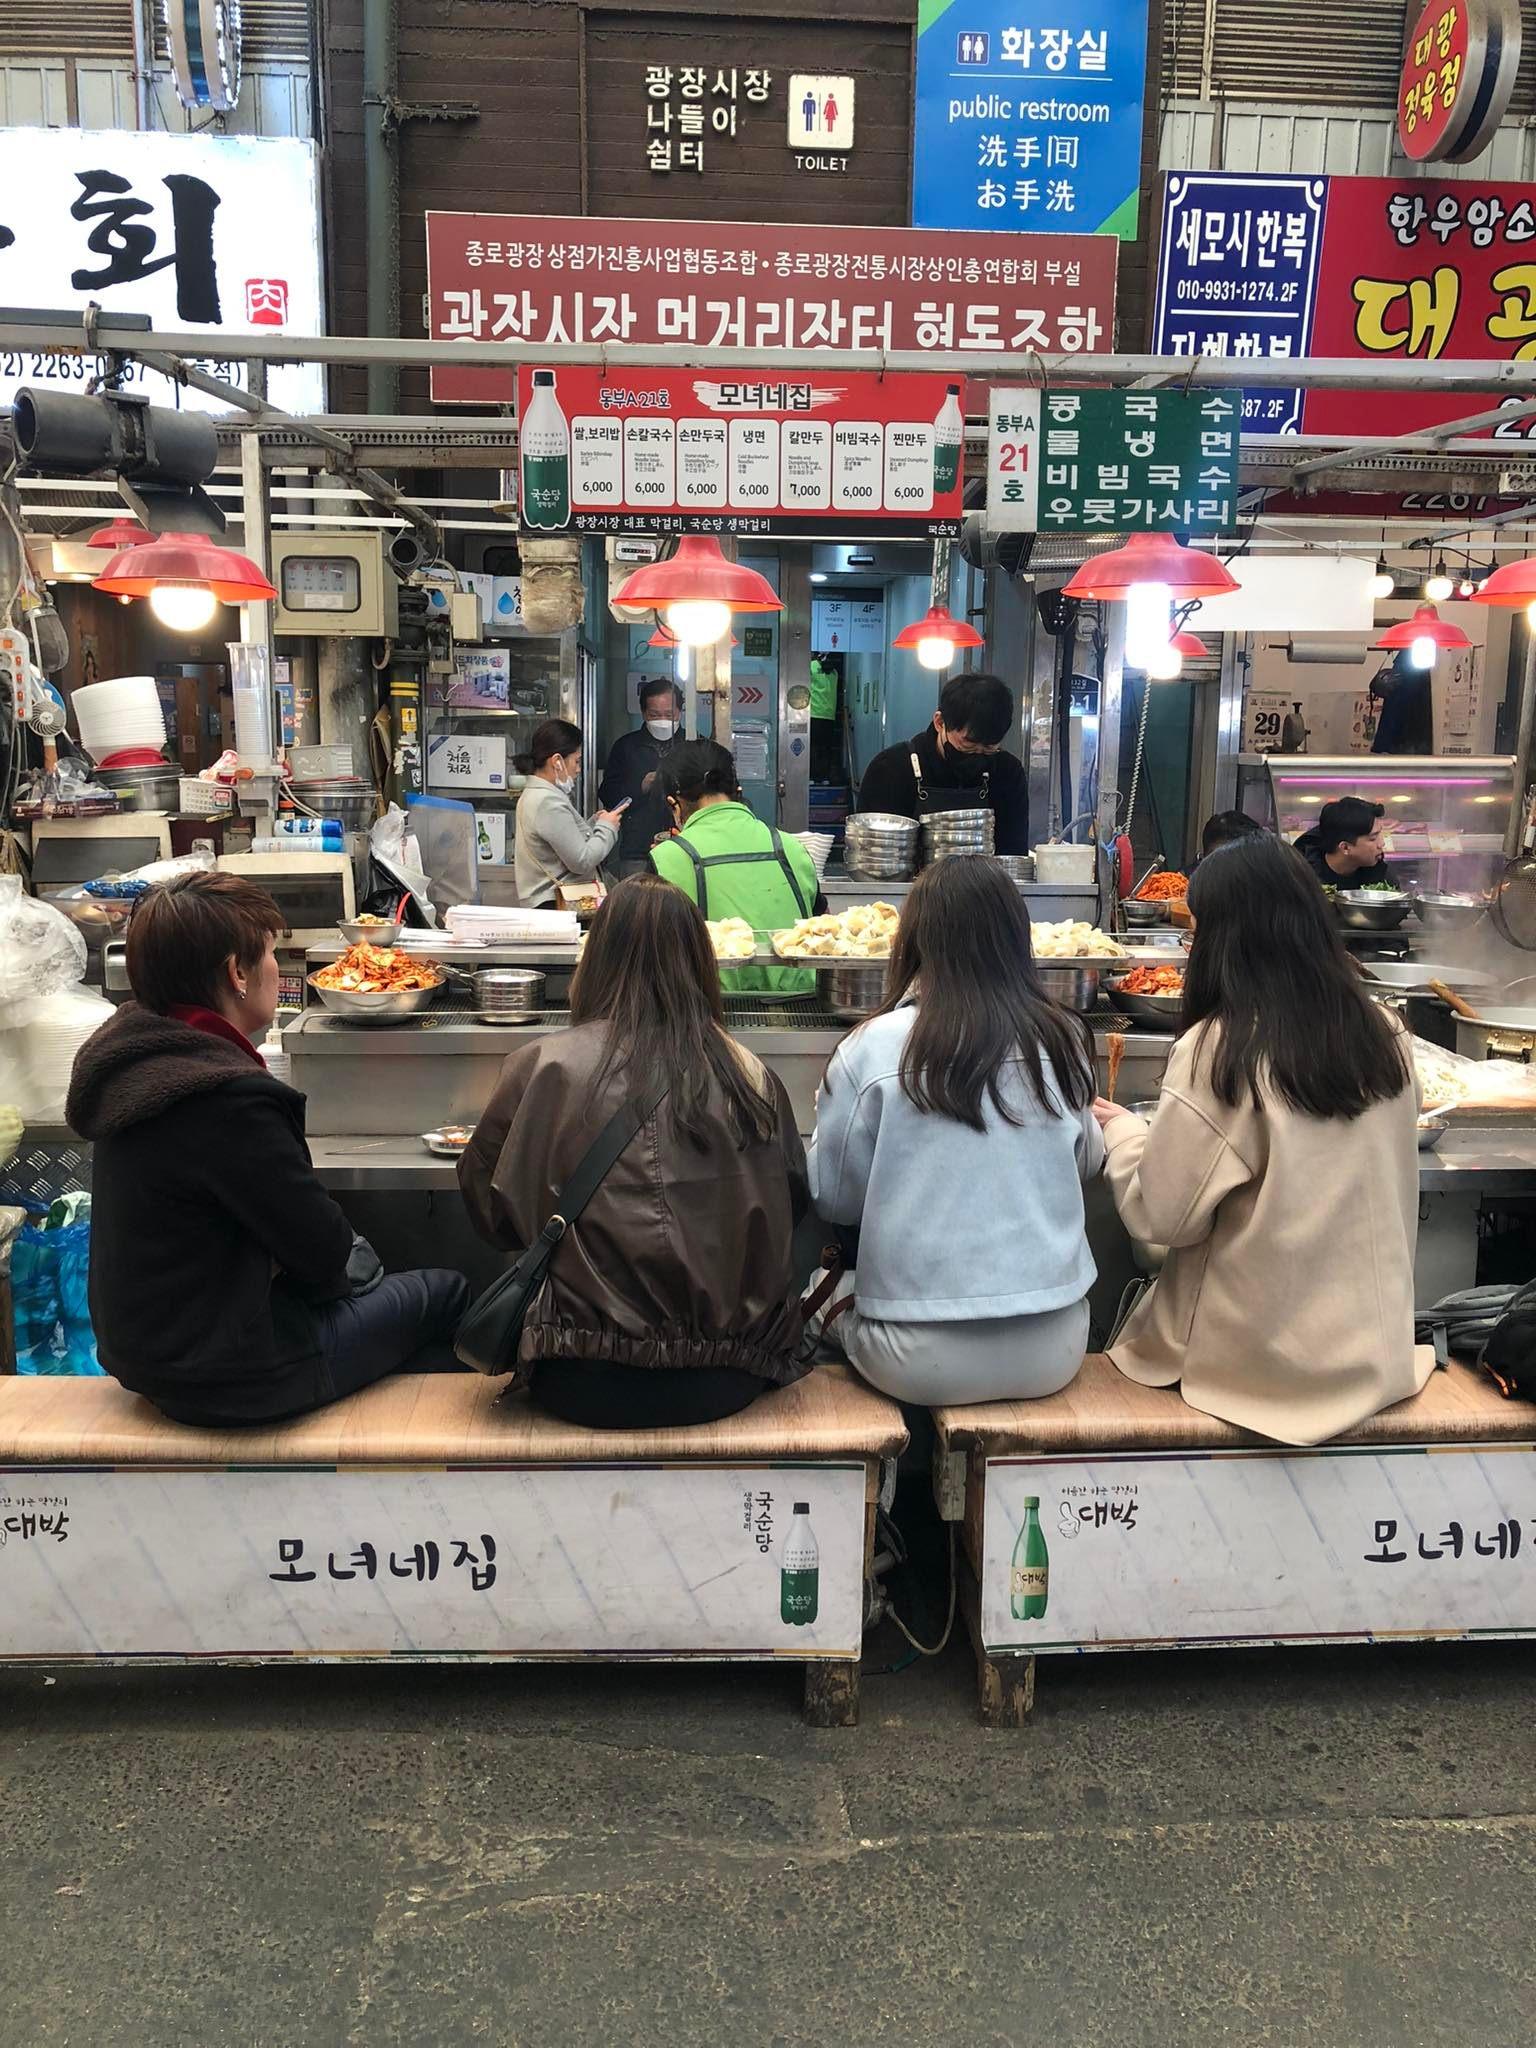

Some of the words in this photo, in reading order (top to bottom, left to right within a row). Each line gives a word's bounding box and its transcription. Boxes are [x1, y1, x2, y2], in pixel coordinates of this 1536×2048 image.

[1415, 7, 1457, 66] 대광
[1001, 28, 1108, 71] 화장실
[645, 66, 772, 101] 광장시장
[1405, 54, 1461, 133] 정육점
[645, 102, 737, 136] 나들이
[948, 95, 1011, 123] public
[1019, 97, 1110, 123] restroom
[646, 139, 704, 171] 쉼터
[795, 155, 848, 171] TOILET
[977, 135, 1078, 169] 洗手间
[977, 180, 1075, 212] お手洗
[70, 169, 222, 325] 회
[1176, 208, 1307, 269] 세모시한복
[1043, 260, 1081, 287] 부설
[1176, 279, 1299, 302] 010-9931-1274.2F
[31, 353, 146, 382] 2263-067
[717, 384, 812, 411] 모녀네집
[573, 426, 621, 442] 쌀,보리밥
[996, 414, 1035, 433] 동부A
[626, 428, 673, 443] 손칼국수
[678, 429, 725, 444] 손만두국
[743, 430, 766, 445] 냉면
[789, 431, 824, 446] 칼만두
[835, 432, 881, 447] 비빔국수
[893, 433, 927, 447] 찐만두
[999, 443, 1029, 472] 21
[582, 481, 613, 495] 6,000
[635, 482, 666, 496] 6,000
[687, 483, 718, 497] 6,000
[738, 484, 769, 497] 6,000
[789, 483, 821, 499] 7,000
[842, 486, 873, 499] 6,000
[894, 487, 925, 500] 6,000
[1001, 479, 1025, 503] 호
[575, 515, 620, 530] 광장시장
[624, 517, 647, 531] 대표
[650, 517, 686, 531] 막걸리,
[689, 518, 724, 532] 국순당
[727, 518, 770, 533] 생막걸리
[829, 603, 841, 613] 3F
[862, 604, 875, 614] 4F
[1254, 712, 1281, 736] 29
[446, 750, 471, 763] 처음
[447, 763, 471, 775] 처럼
[3, 1510, 70, 1543] 대박
[754, 1491, 775, 1553] 국순당
[1078, 1499, 1139, 1531] 대박
[1363, 1518, 1536, 1563] 모녀네
[269, 1537, 499, 1592] 모녀네집
